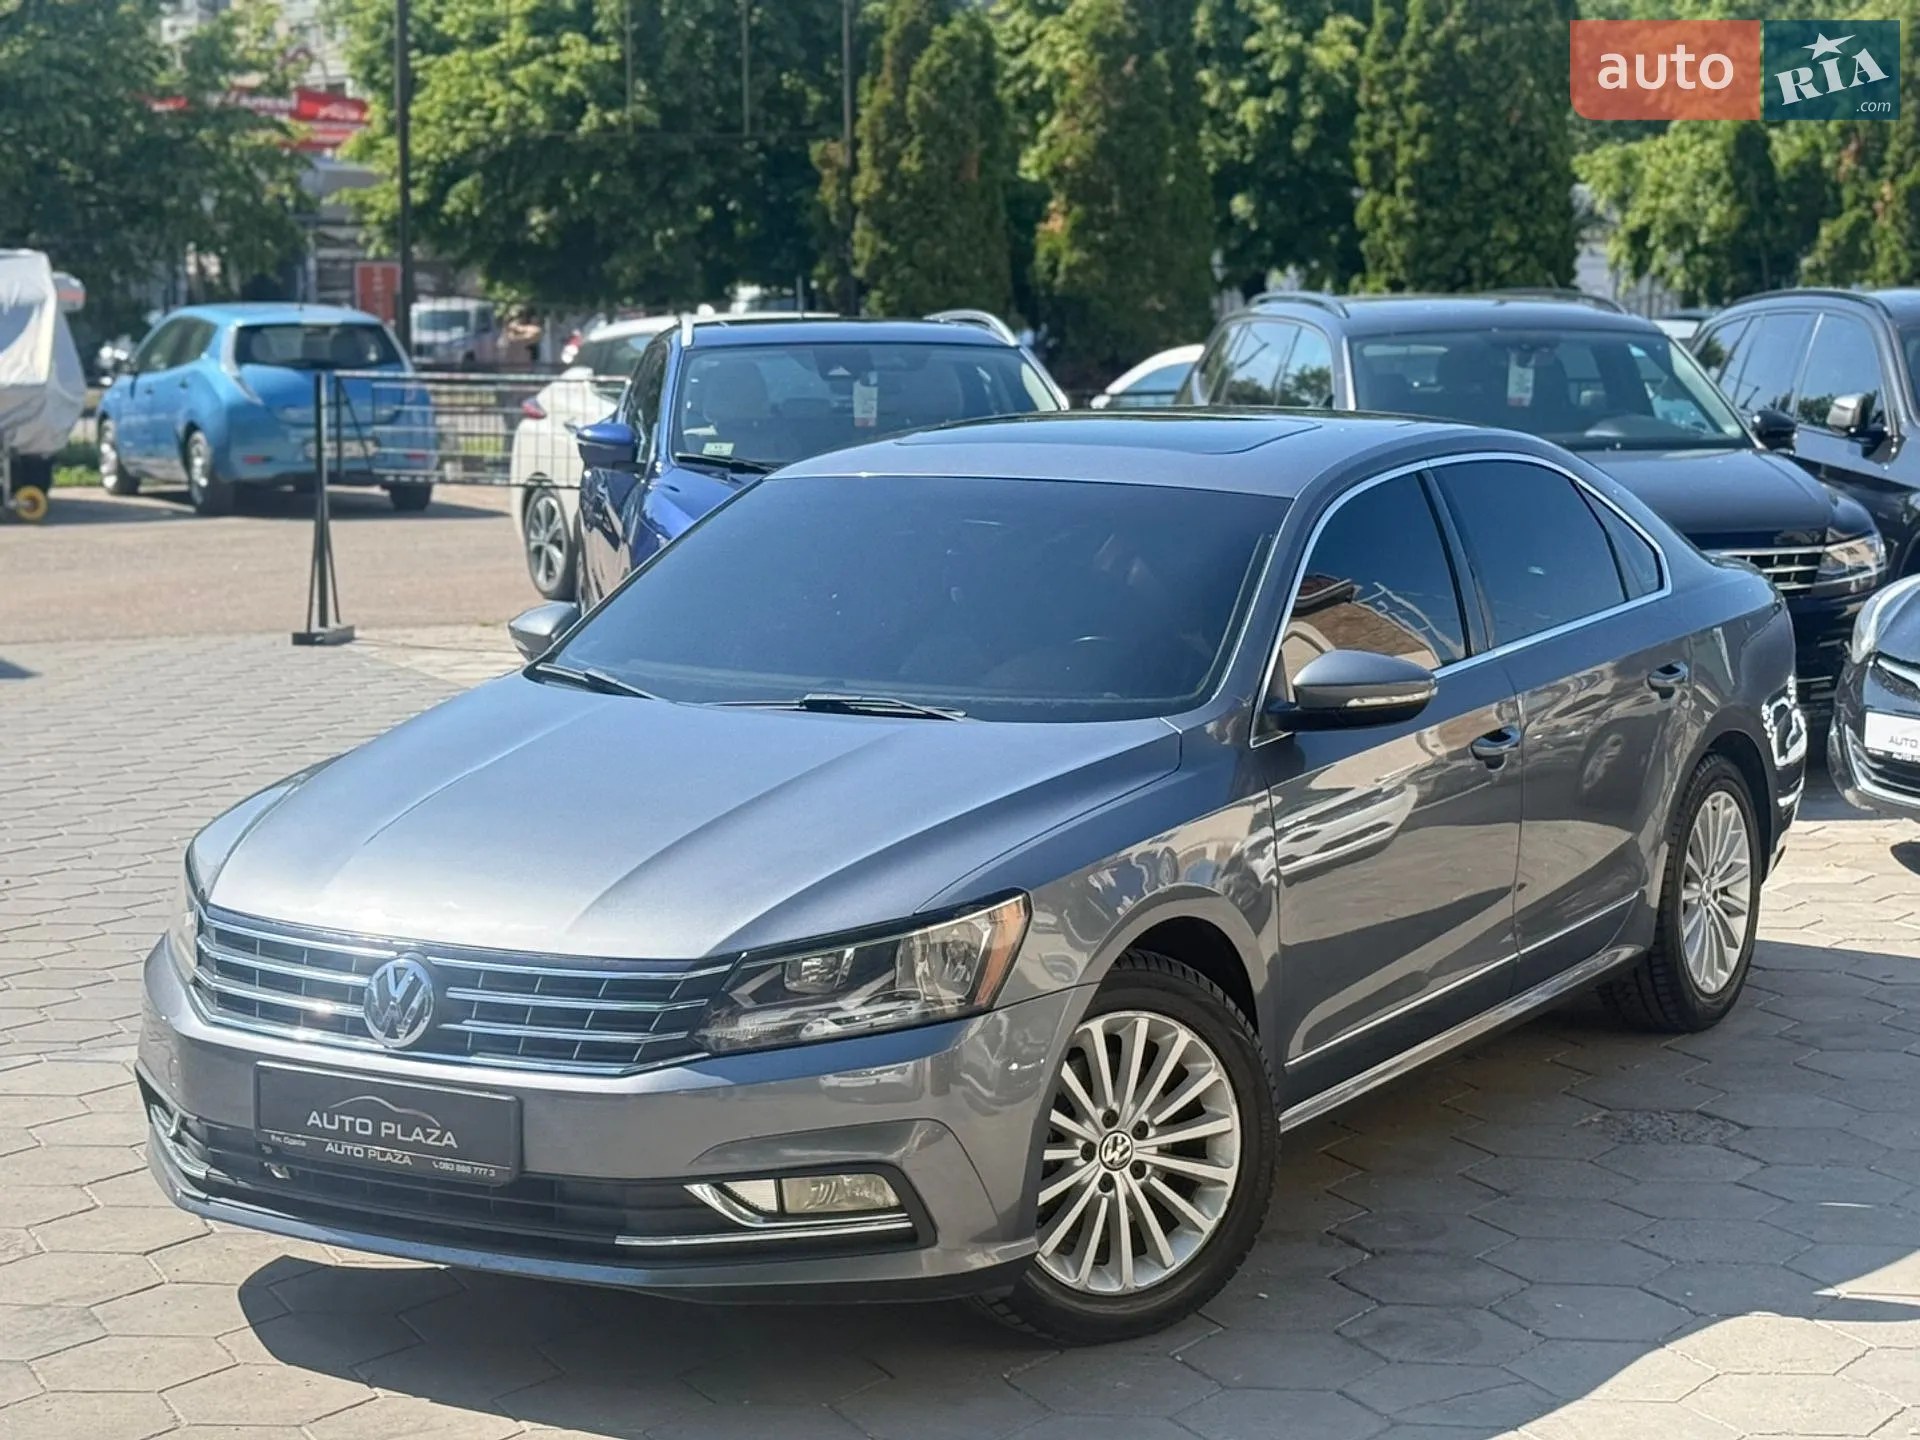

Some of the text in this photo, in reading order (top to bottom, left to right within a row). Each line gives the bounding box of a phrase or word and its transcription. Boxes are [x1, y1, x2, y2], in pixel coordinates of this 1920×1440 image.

[1888, 735, 1918, 749] AUTO
[307, 1110, 458, 1149] AUTO PLAZA
[325, 1141, 412, 1166] AUTO PLAZA
